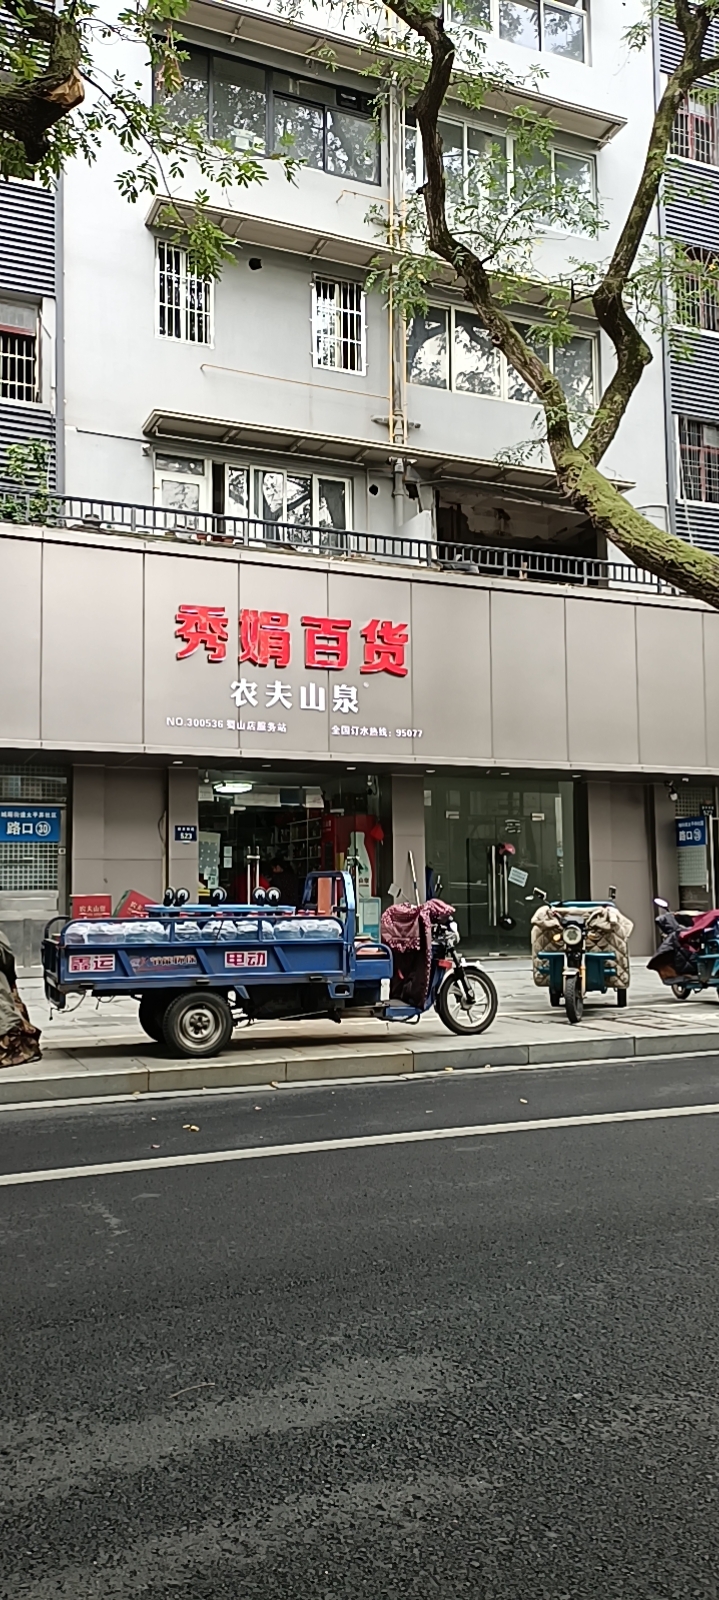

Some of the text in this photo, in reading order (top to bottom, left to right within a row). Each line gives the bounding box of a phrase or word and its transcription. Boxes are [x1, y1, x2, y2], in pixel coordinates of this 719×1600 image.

[175, 604, 408, 677] 秀娟百货
[230, 678, 359, 713] 农夫山泉
[226, 952, 266, 967] 电动
